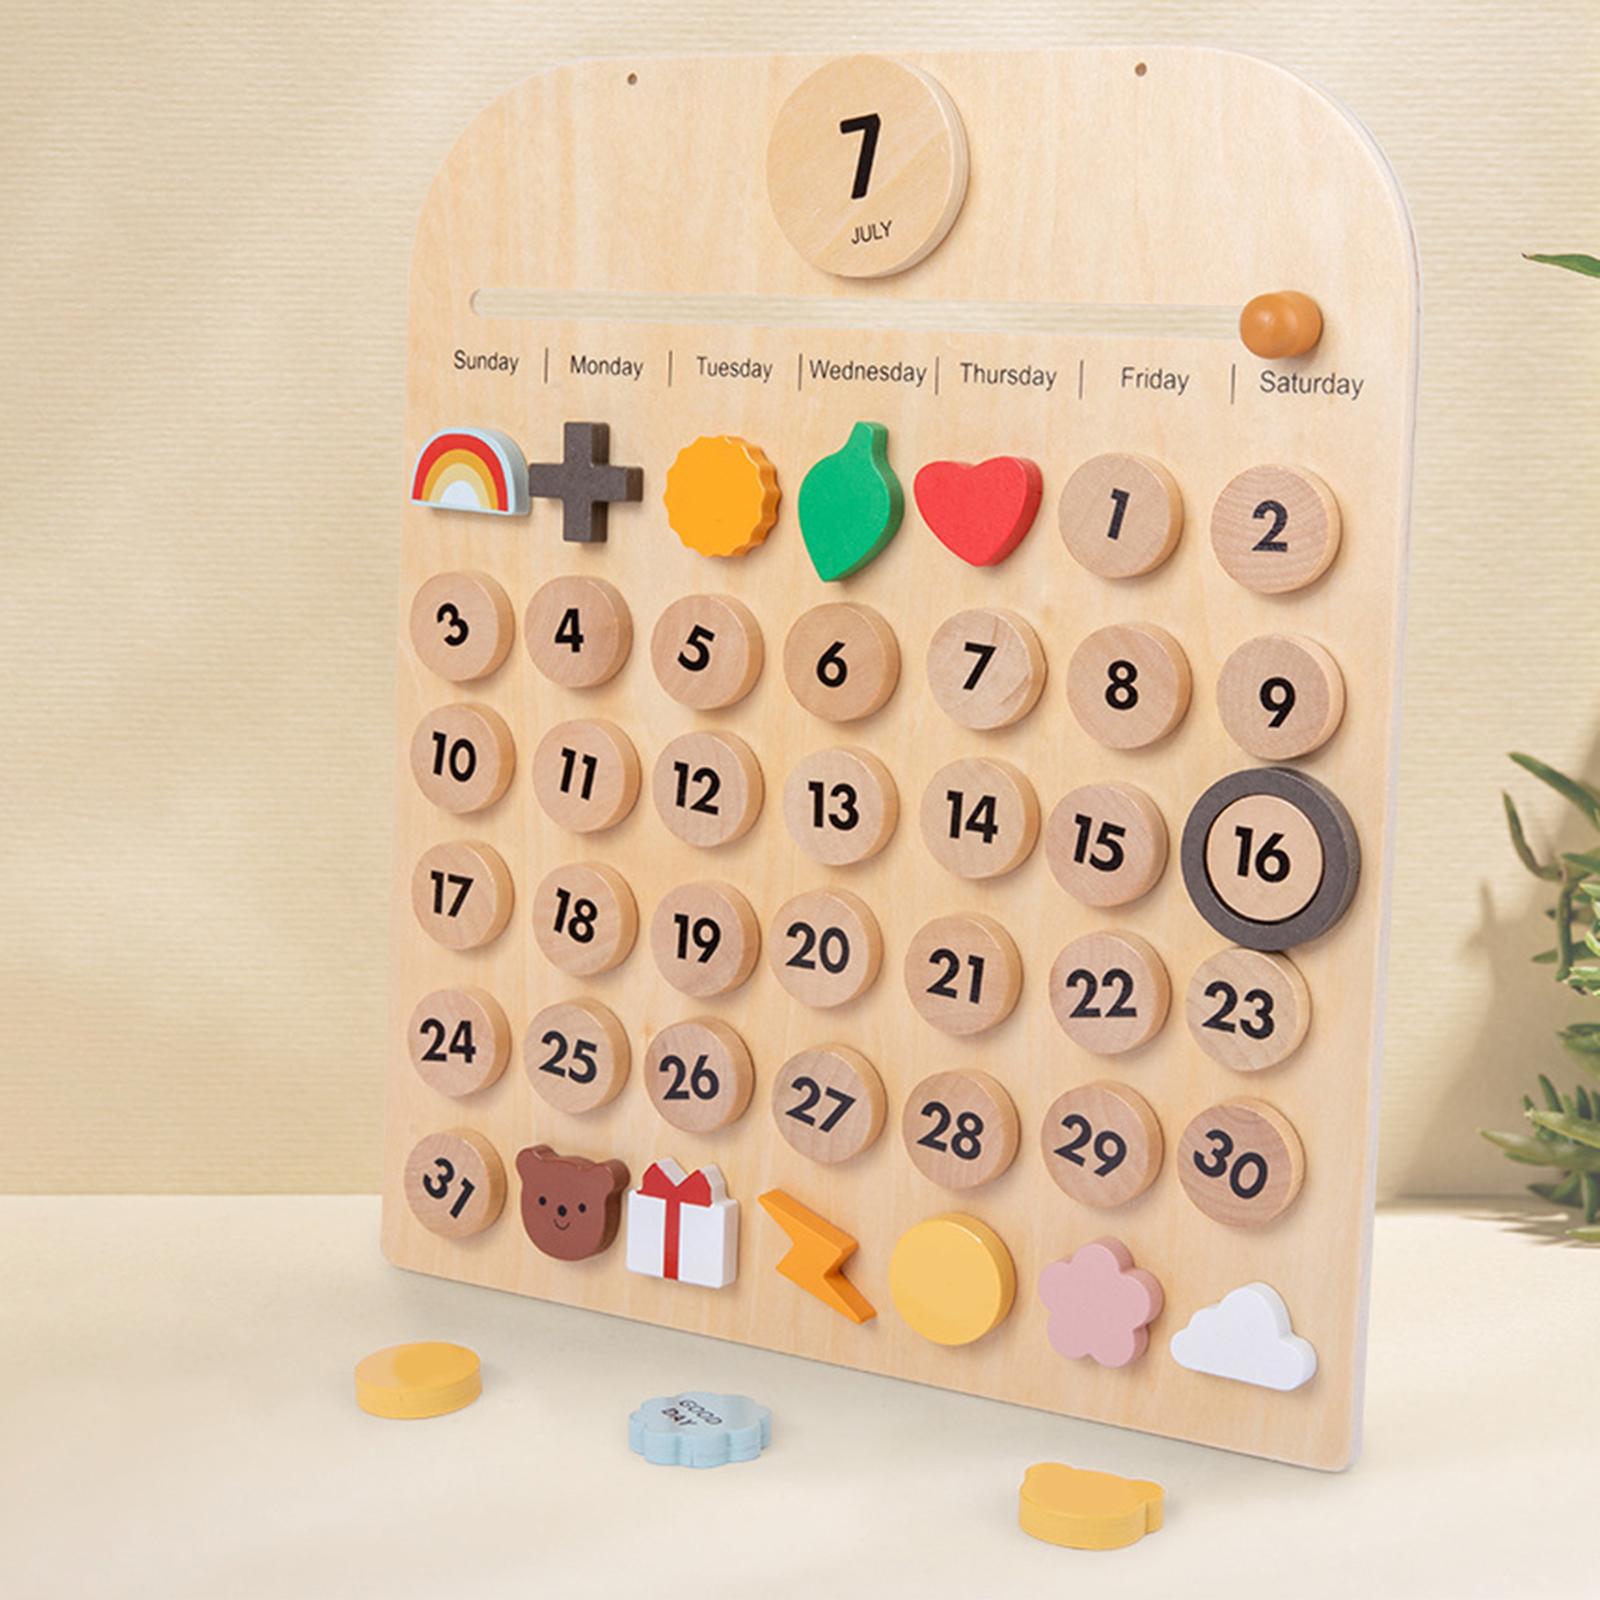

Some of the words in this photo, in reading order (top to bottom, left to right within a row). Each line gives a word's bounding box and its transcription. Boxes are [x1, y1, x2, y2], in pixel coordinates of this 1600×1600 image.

[838, 112, 882, 201] 7
[850, 220, 893, 246] JULY
[453, 350, 520, 377] Sunday
[569, 354, 645, 382] Monday
[695, 355, 773, 384] Tuesday
[808, 358, 928, 387] Wednesday
[959, 362, 1057, 391] Thursday
[1120, 366, 1191, 396] Friday
[1258, 369, 1364, 401] Saturday
[1106, 488, 1130, 540] 1
[1251, 500, 1288, 552] 2
[435, 603, 469, 647] 3
[553, 608, 584, 653] 4
[676, 624, 715, 672] 5
[815, 641, 848, 688] 6
[962, 642, 996, 691] 7
[1104, 660, 1138, 711] 8
[1258, 677, 1296, 728] 9
[431, 731, 477, 782] 10
[559, 747, 598, 801] 11
[673, 761, 721, 816] 12
[807, 781, 859, 831] 13
[946, 790, 998, 844] 14
[1072, 813, 1126, 872] 15
[1234, 825, 1291, 883] 16
[429, 870, 474, 918] 17
[552, 887, 598, 944] 18
[673, 913, 721, 964] 19
[785, 922, 850, 974] 20
[925, 948, 985, 1004] 21
[1065, 968, 1137, 1018] 22
[1201, 981, 1275, 1040] 23
[419, 1018, 476, 1064] 24
[538, 1030, 597, 1084] 25
[658, 1055, 719, 1100] 26
[784, 1076, 856, 1133] 27
[916, 1101, 984, 1160] 28
[1053, 1114, 1127, 1177] 29
[422, 1157, 475, 1219] 31
[1192, 1129, 1268, 1199] 30
[661, 1407, 697, 1426] DAY
[679, 1399, 722, 1425] GOOD
